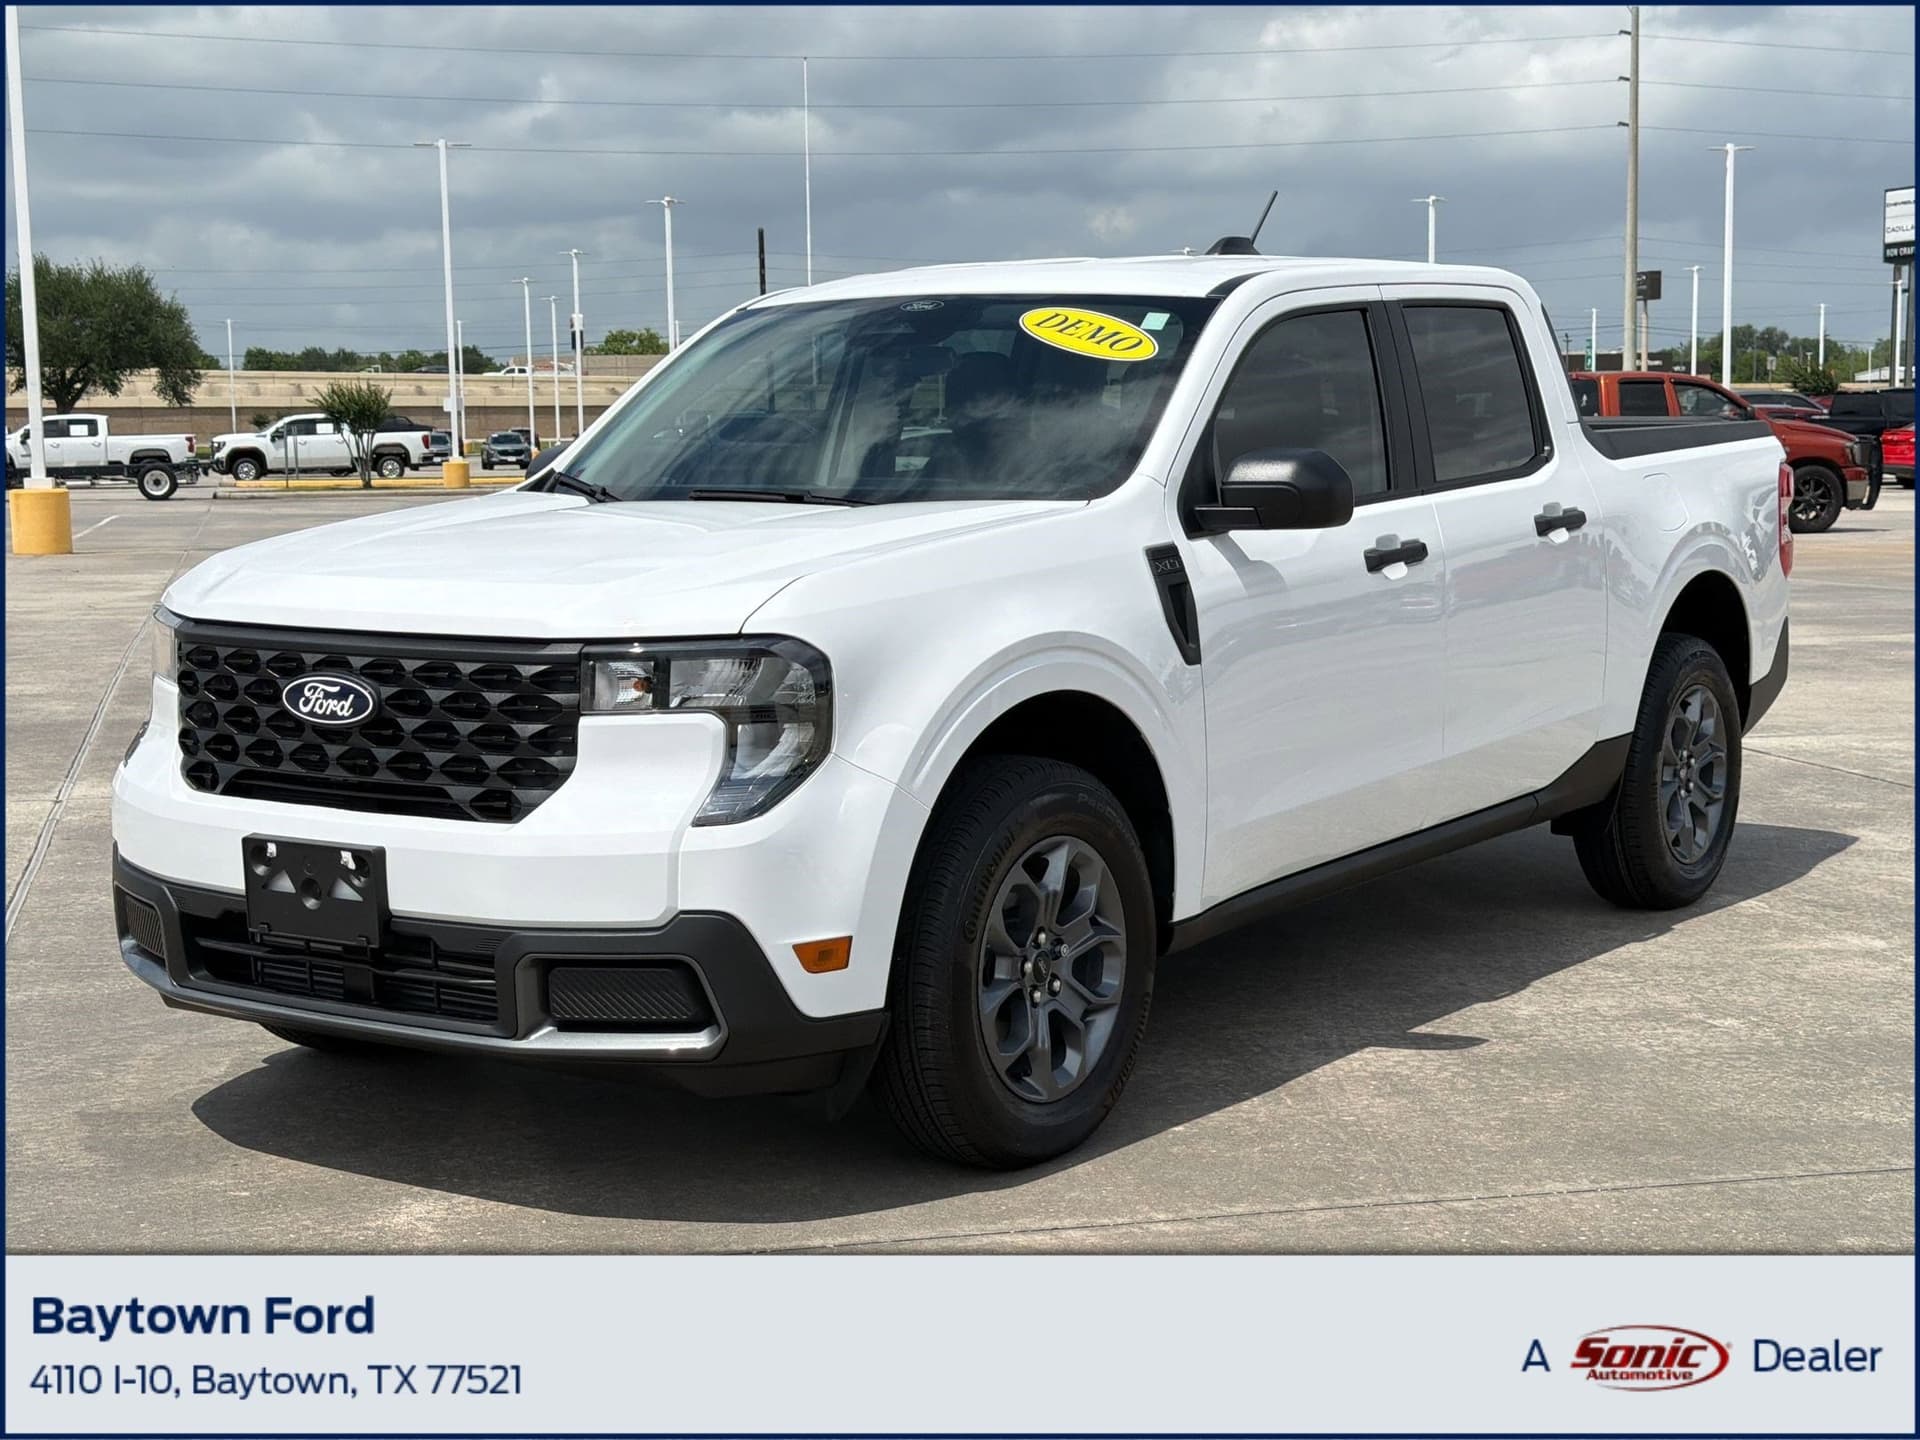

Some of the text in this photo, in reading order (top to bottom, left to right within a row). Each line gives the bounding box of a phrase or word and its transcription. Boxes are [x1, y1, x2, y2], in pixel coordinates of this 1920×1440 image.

[1032, 311, 1144, 352] DEMO
[1154, 559, 1181, 573] XLT
[298, 682, 355, 716] Ford
